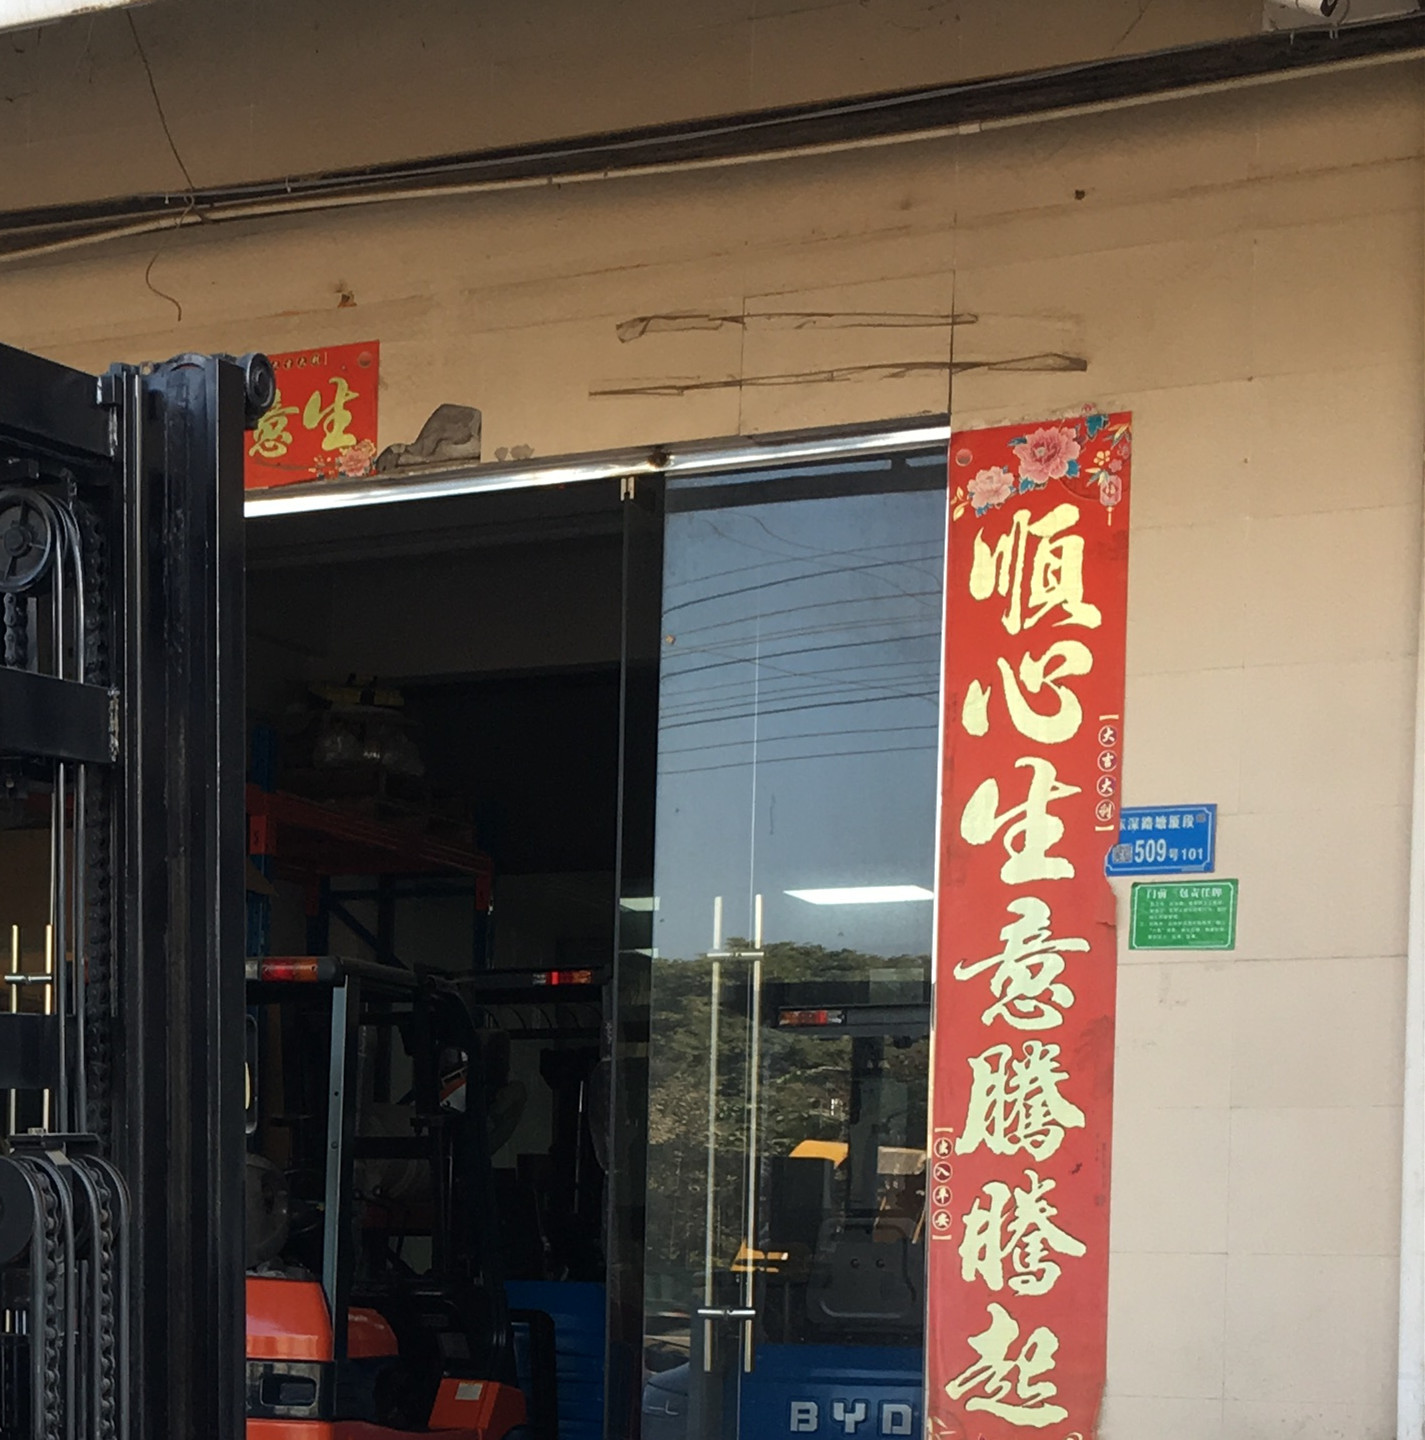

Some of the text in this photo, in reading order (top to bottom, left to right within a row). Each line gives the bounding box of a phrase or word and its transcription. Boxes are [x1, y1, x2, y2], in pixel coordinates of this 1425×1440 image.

[1097, 725, 1117, 821] 大吉大利
[790, 1401, 913, 1436] BYD
